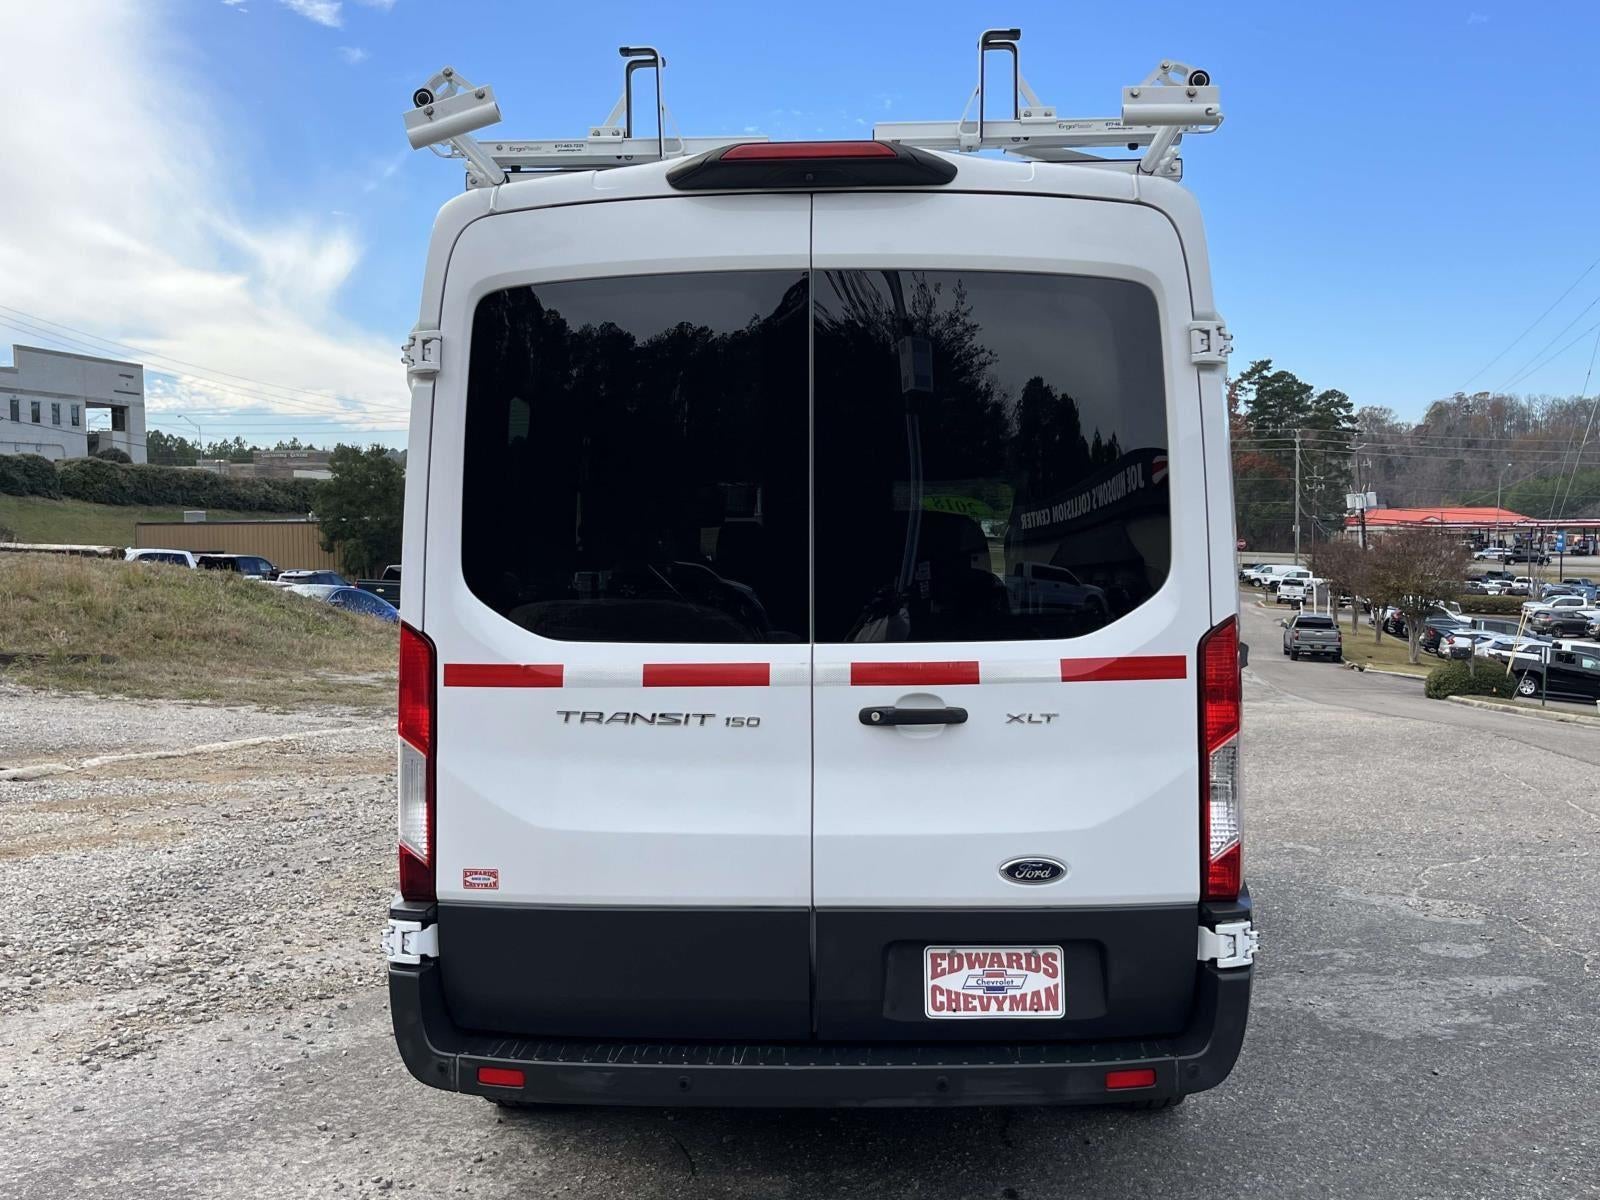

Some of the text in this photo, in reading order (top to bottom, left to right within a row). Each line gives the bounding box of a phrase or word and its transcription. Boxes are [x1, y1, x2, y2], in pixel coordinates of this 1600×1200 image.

[556, 710, 761, 728] TRANSIT 150
[1005, 712, 1060, 725] XLT
[1015, 862, 1052, 879] Ford
[930, 951, 1059, 981] EDWARDS
[975, 978, 1015, 987] Chevrolet
[930, 982, 1060, 1013] CHEVYMAN
